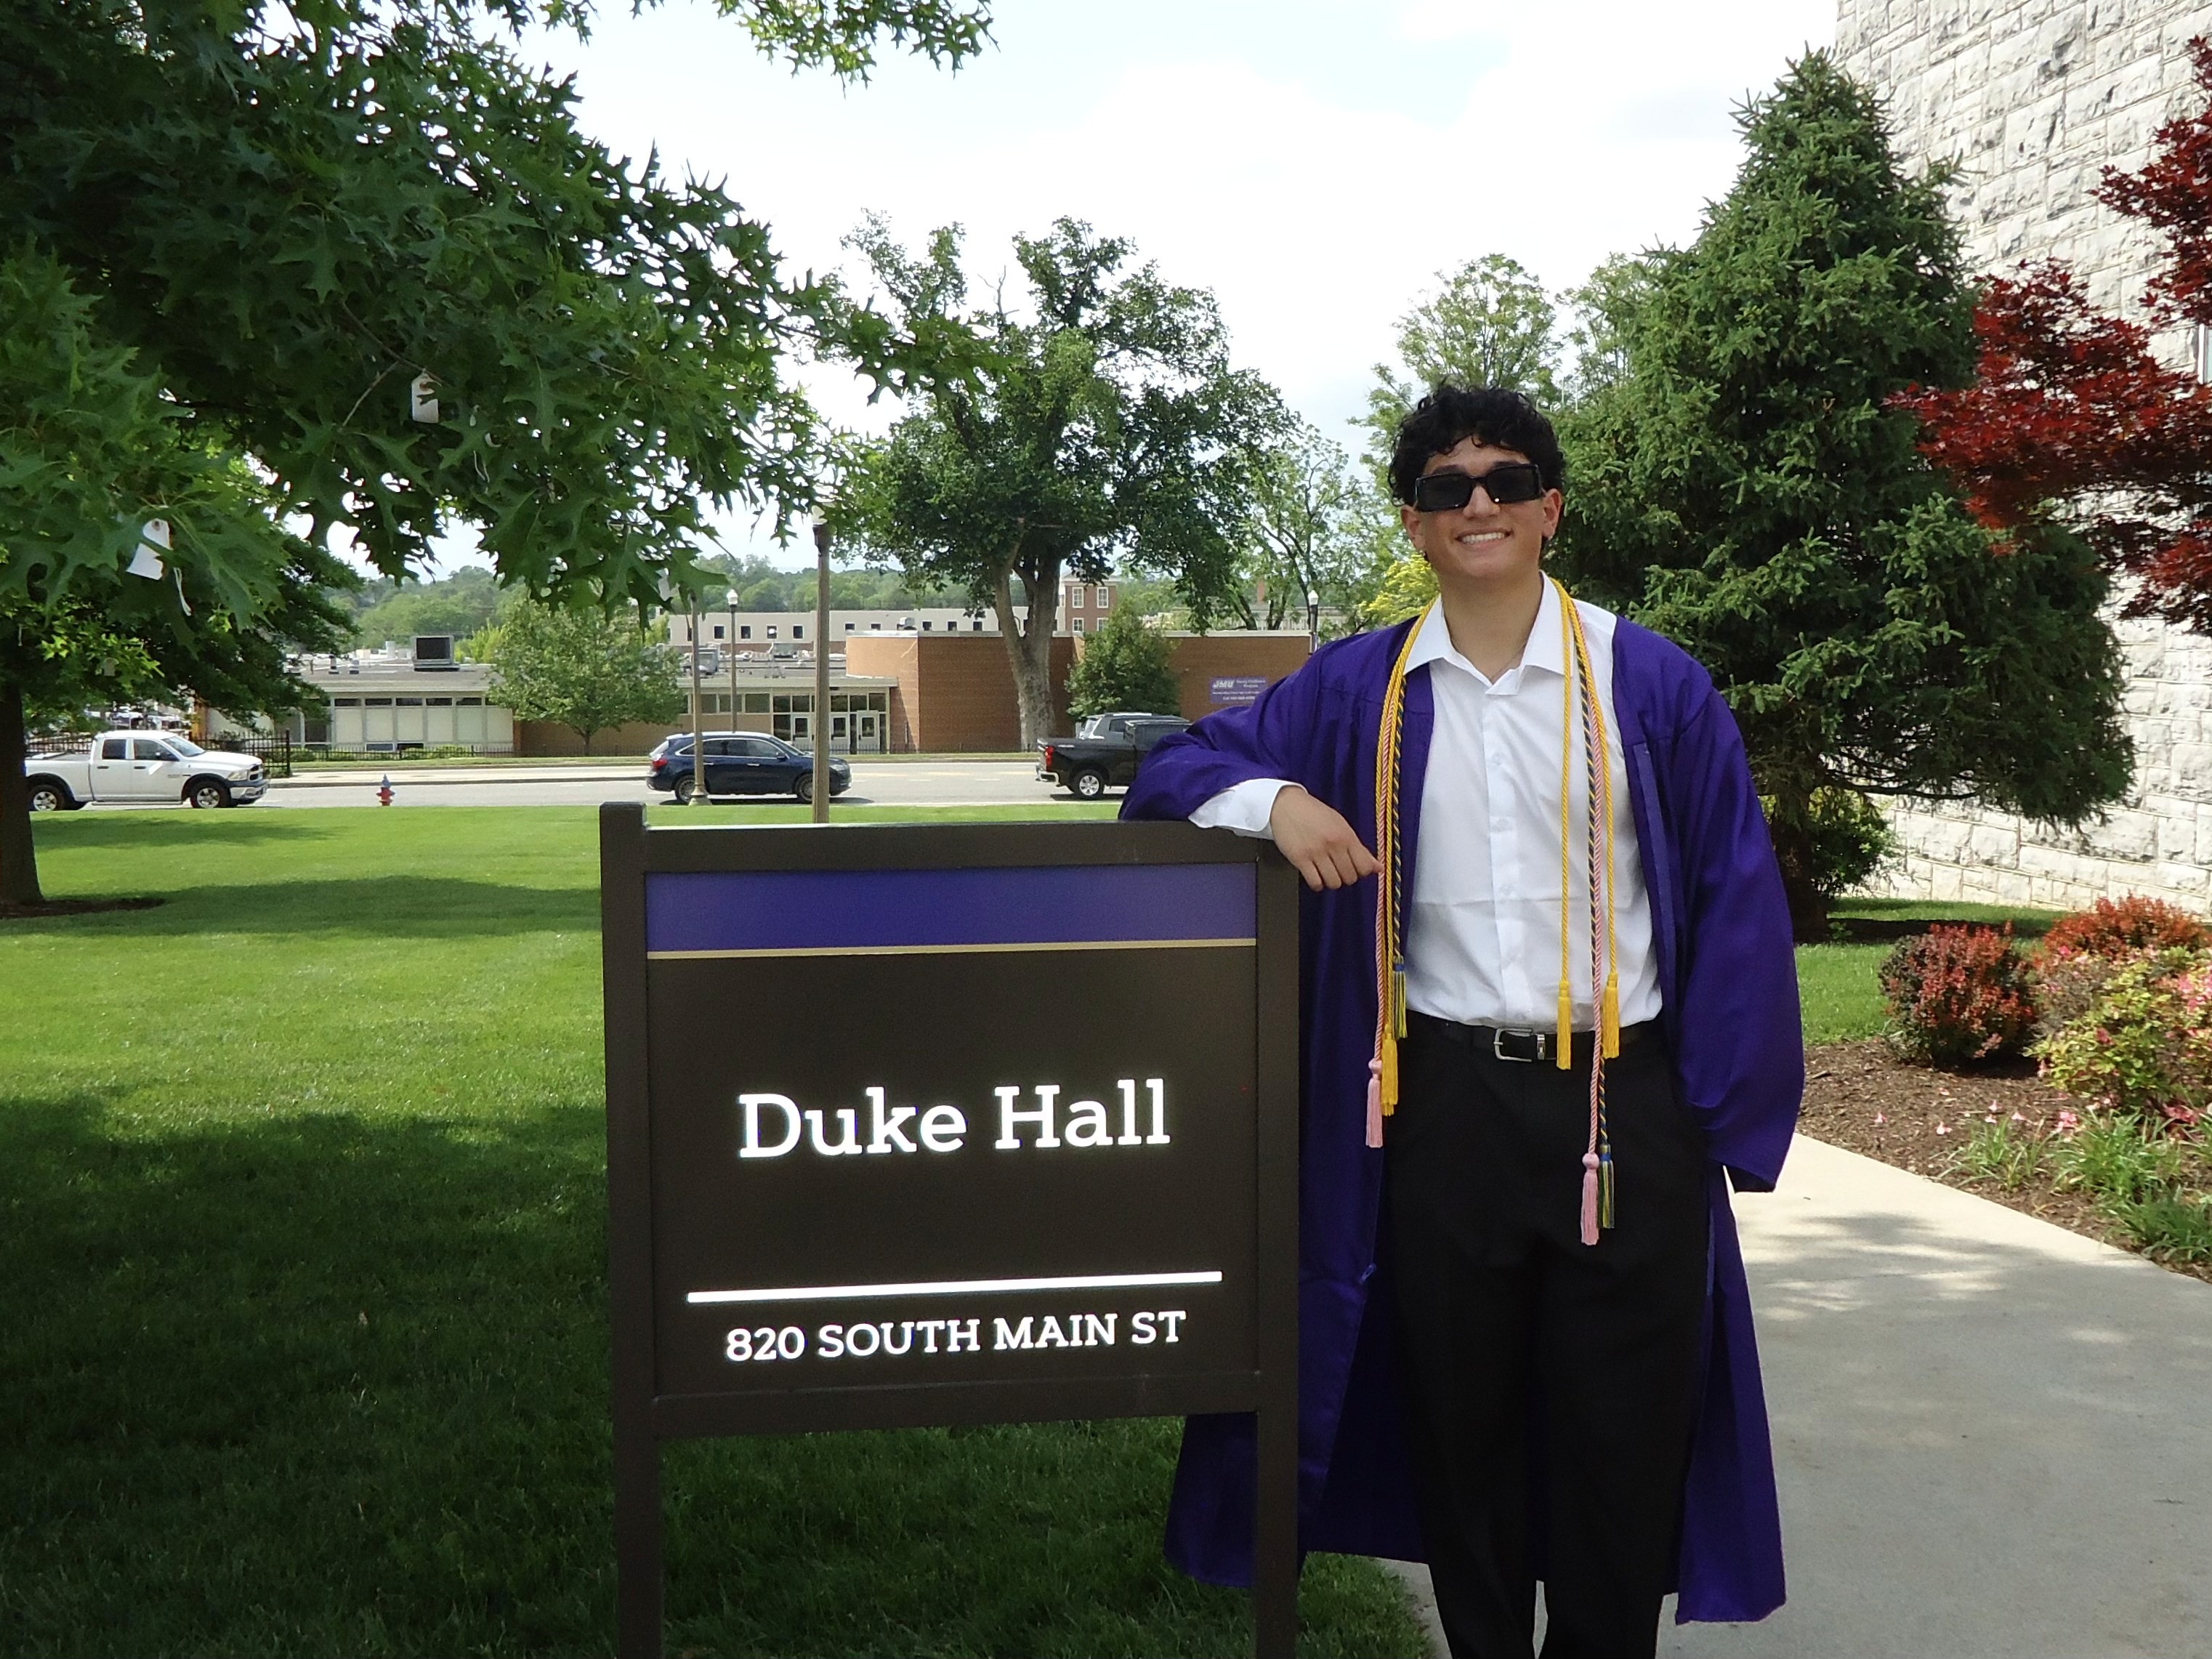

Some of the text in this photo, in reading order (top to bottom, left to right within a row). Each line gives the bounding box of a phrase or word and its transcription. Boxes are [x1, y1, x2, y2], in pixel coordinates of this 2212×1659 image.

[1212, 679, 1235, 689] JMU
[738, 1078, 1171, 1158] Duke Hall
[725, 1309, 1187, 1362] 820 SOUTH MAIN ST
